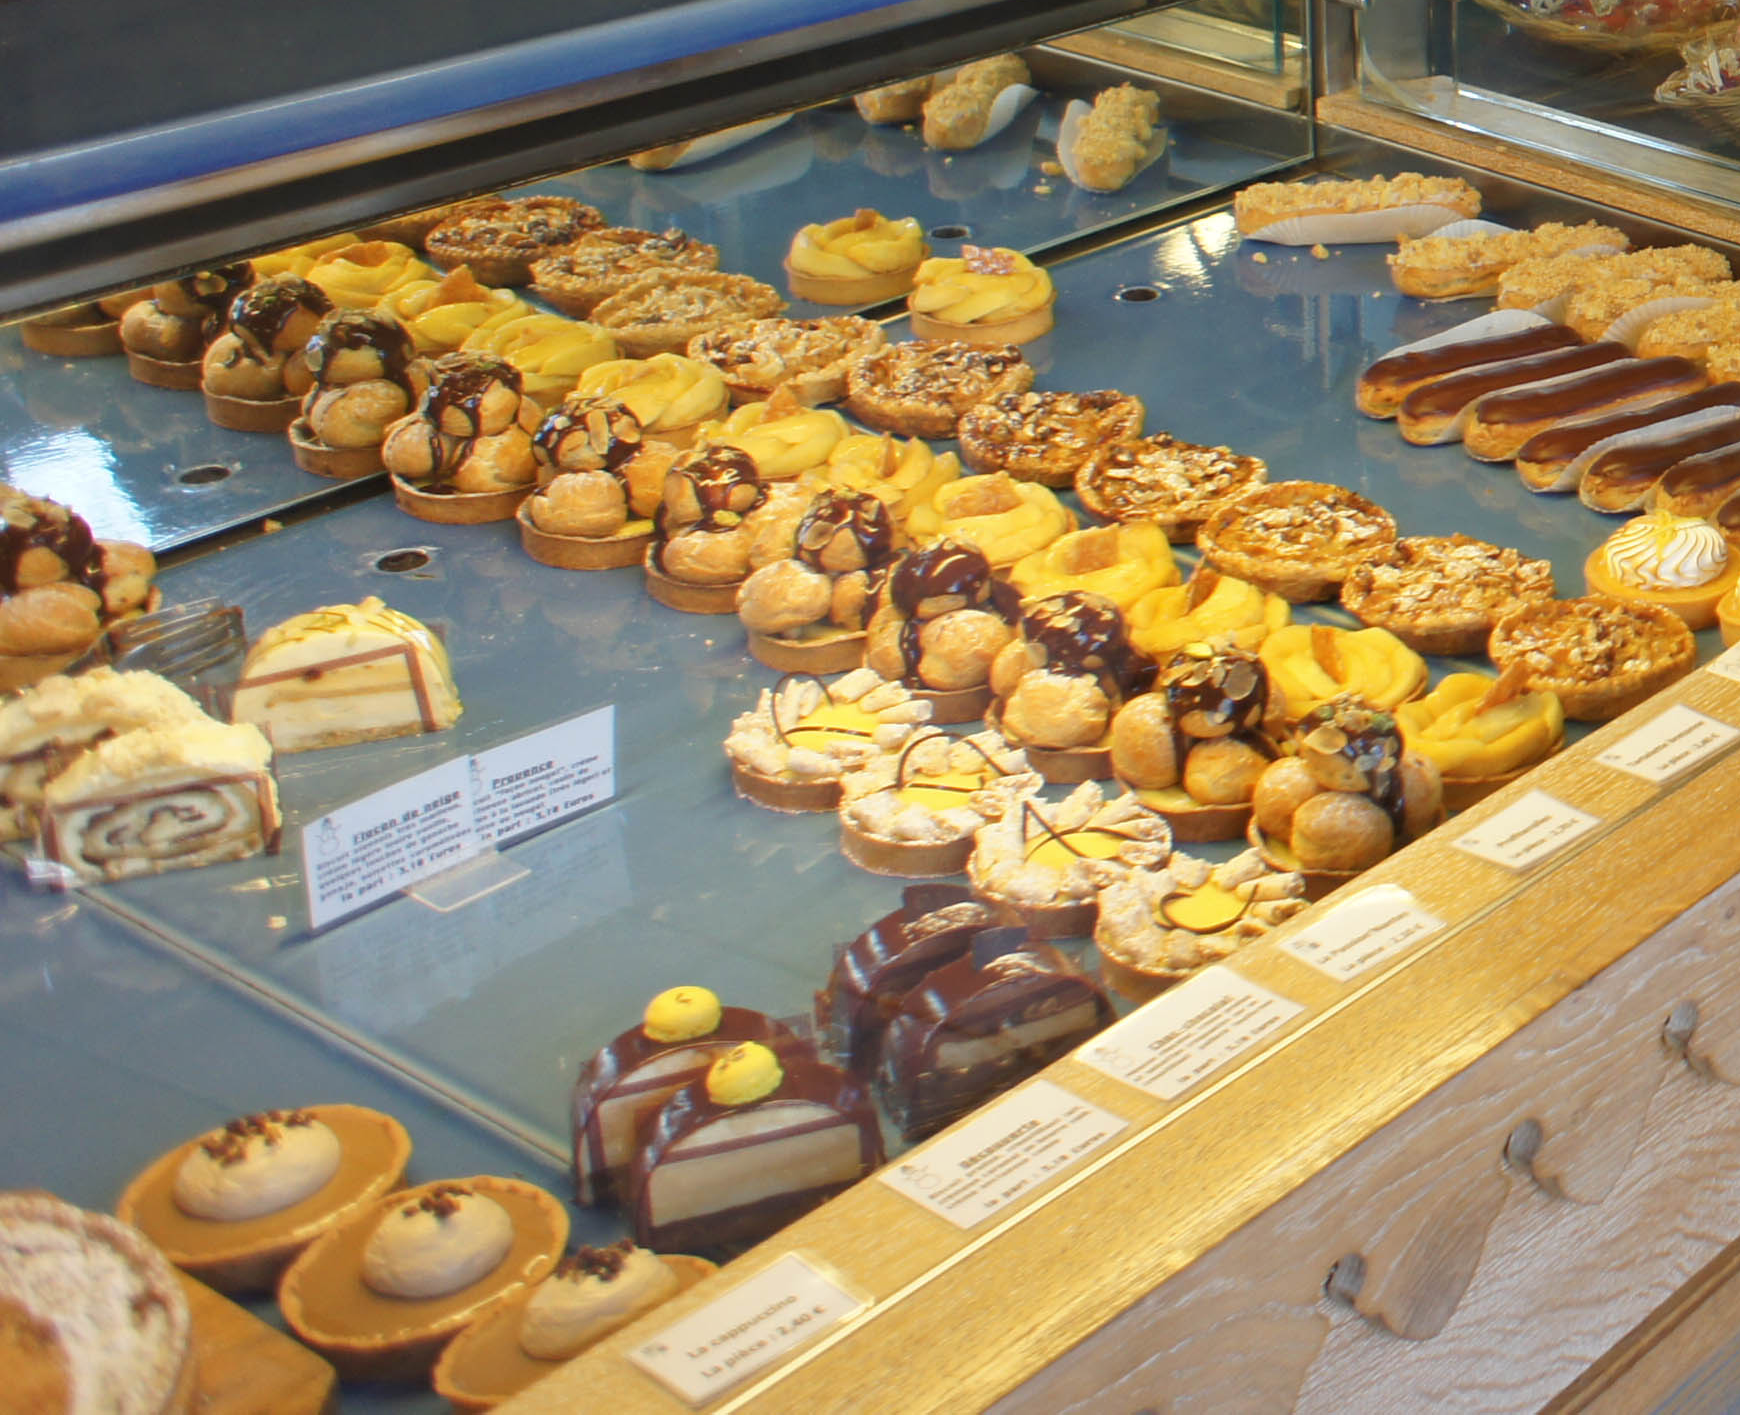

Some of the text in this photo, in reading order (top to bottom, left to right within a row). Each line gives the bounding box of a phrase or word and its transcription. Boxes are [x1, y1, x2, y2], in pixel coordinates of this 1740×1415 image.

[401, 804, 419, 824] de
[358, 875, 384, 896] part
[429, 839, 461, 863] Euros
[684, 1292, 800, 1360] La cappuccino
[719, 1336, 770, 1368] pièce
[807, 1303, 828, 1316] €
